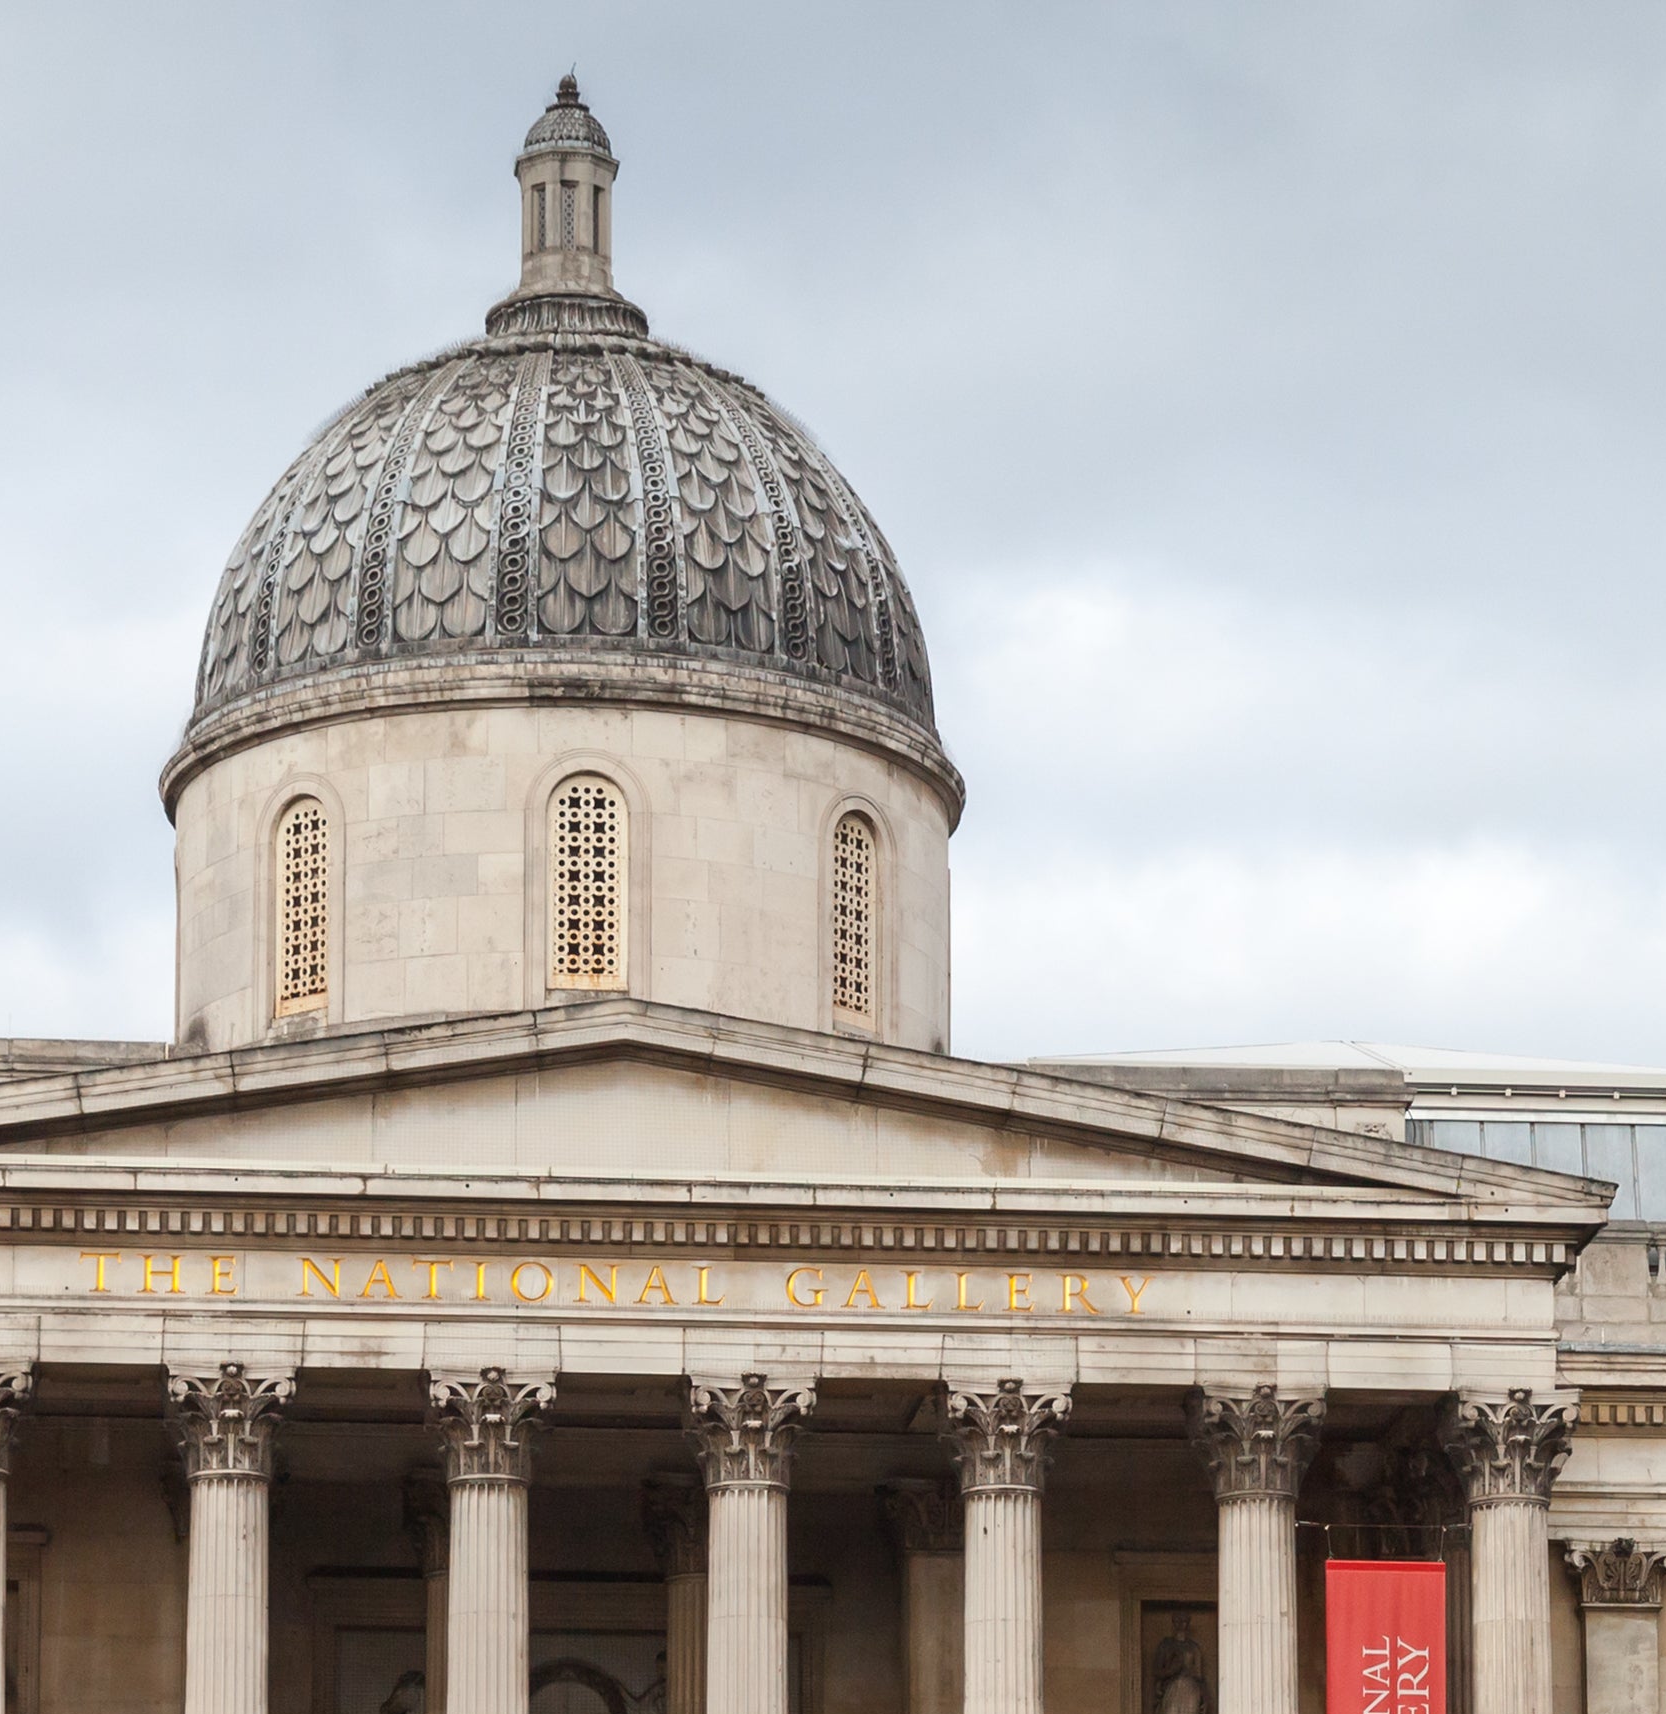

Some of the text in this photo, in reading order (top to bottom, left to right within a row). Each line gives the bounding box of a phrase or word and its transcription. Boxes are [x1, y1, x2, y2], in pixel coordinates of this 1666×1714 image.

[79, 1250, 1154, 1316] THE NATIONAL GALLERY
